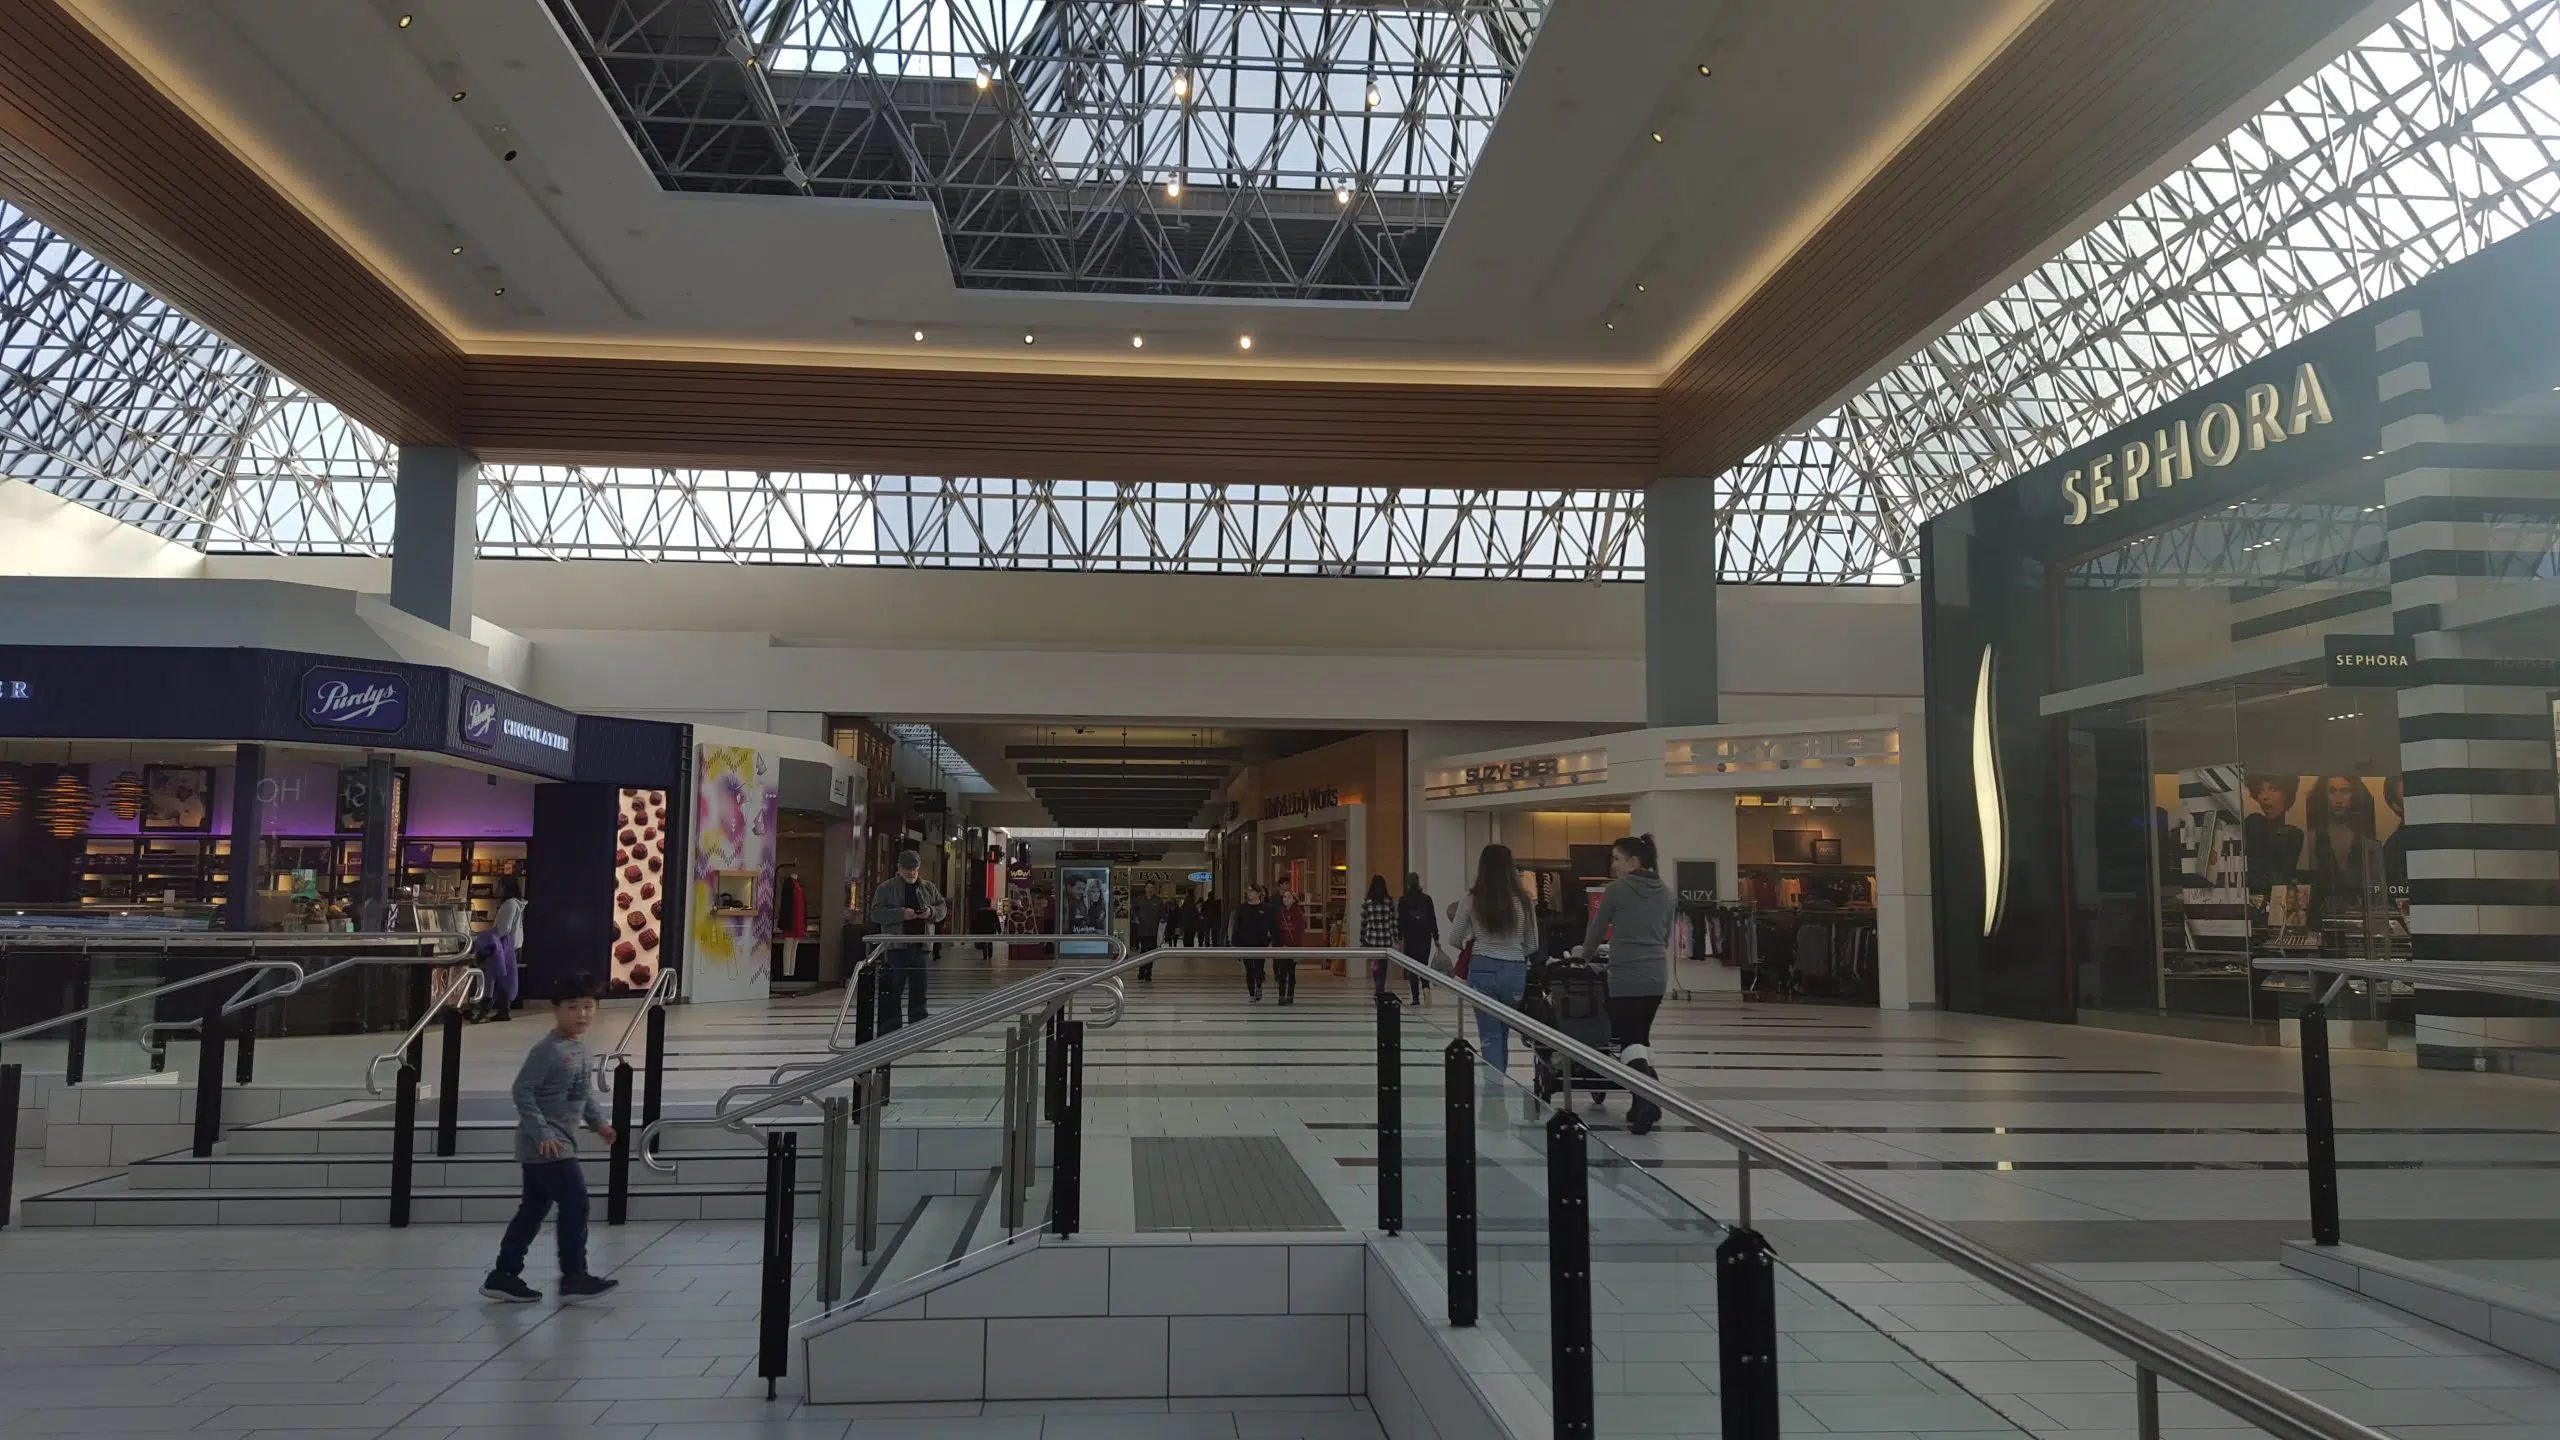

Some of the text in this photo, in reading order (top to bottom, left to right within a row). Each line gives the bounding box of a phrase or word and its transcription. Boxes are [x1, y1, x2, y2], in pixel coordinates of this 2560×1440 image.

[2061, 362, 2333, 525] SEPHORA
[2335, 654, 2409, 667] SEPHORA
[0, 680, 31, 699] R
[312, 680, 400, 722] Purdys
[502, 718, 571, 752] CHOCOLATIER
[1466, 763, 1508, 785] SUZY
[1138, 871, 1173, 881] BAY
[1680, 889, 1713, 901] SUZY
